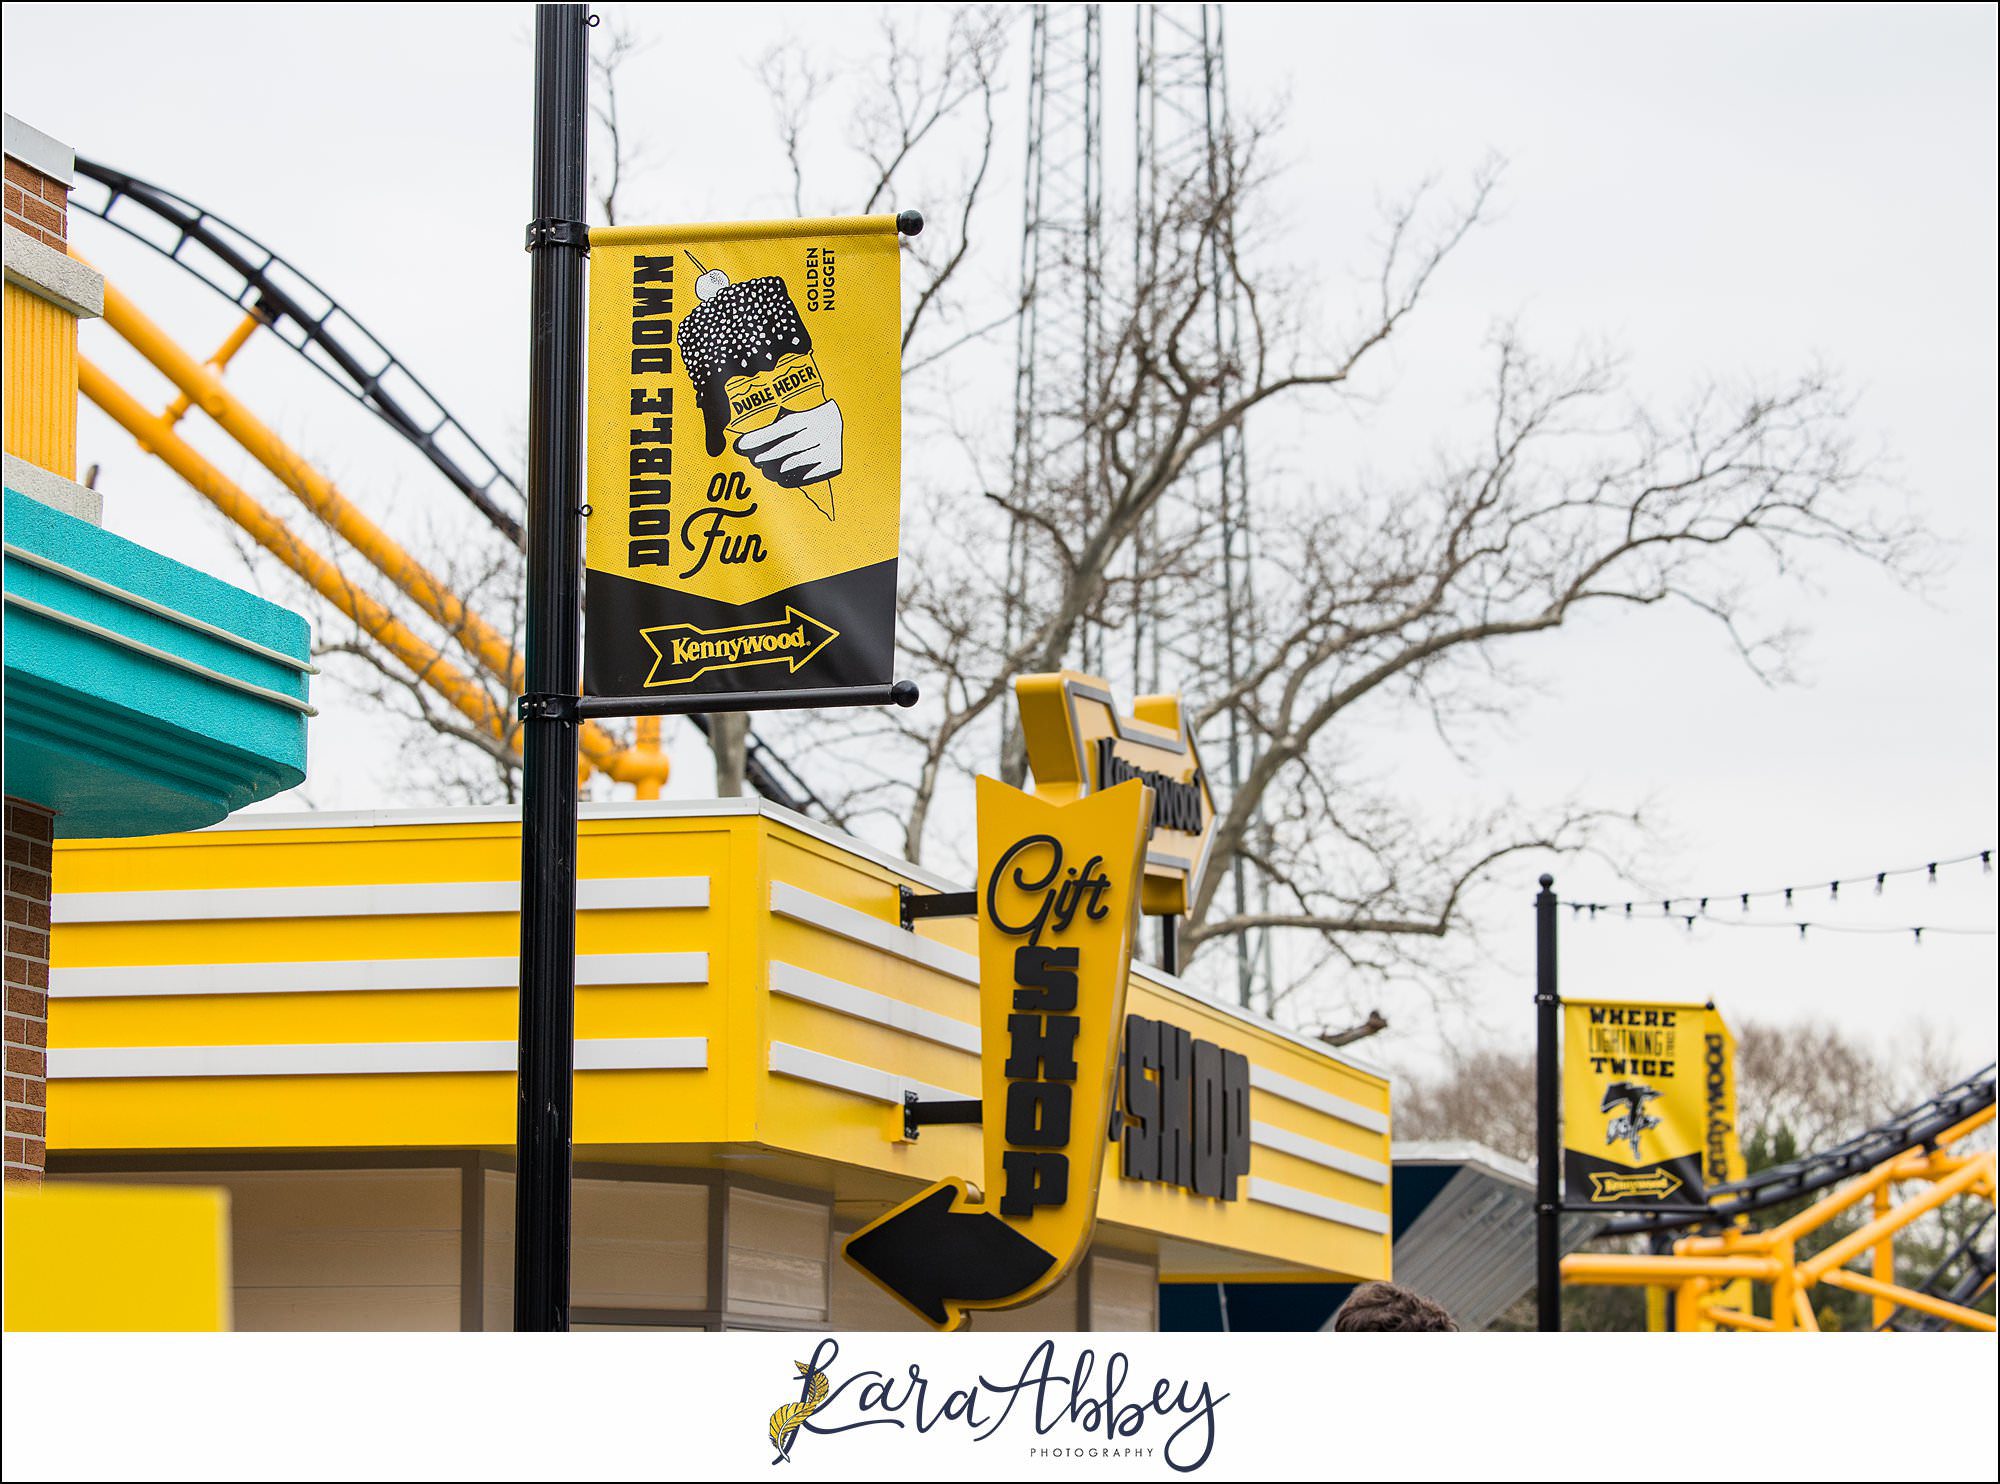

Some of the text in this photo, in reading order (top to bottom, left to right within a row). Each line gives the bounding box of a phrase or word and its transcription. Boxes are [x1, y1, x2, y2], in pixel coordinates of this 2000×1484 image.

[806, 247, 819, 312] GOLDEN
[823, 247, 836, 311] NUGGET
[628, 255, 674, 568] DOUBLE DOWN
[732, 366, 817, 416] DUBLE HEDER
[706, 471, 752, 502] on
[679, 502, 768, 579] Fun
[671, 624, 806, 665] Kennywood
[986, 834, 1111, 947] Gift
[1588, 1027, 1663, 1056] LIGHTNING
[1589, 1007, 1676, 1027] WHERE
[1000, 946, 1080, 1217] SHOP
[1590, 1057, 1675, 1078] TWICE
[1125, 1014, 1250, 1202] SHOP
[1705, 1033, 1732, 1183] ennywood
